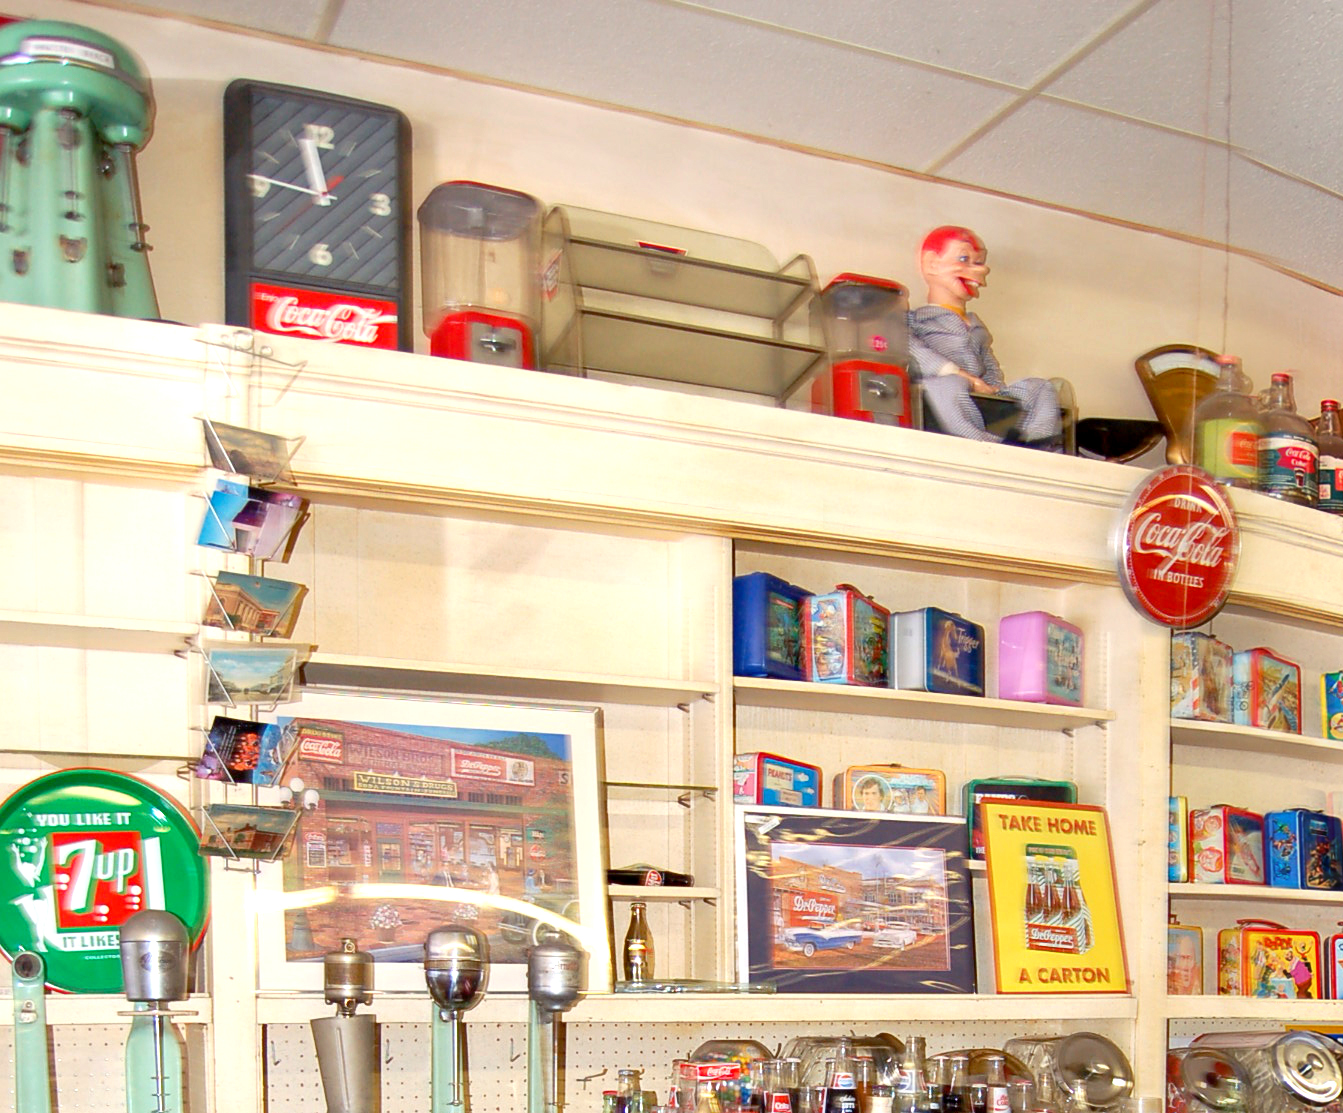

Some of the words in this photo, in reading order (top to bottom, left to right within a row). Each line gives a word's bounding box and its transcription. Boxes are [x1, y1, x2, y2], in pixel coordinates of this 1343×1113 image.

[369, 192, 392, 217] 3
[308, 243, 333, 266] 6
[266, 296, 384, 343] Coca-Cola
[1285, 448, 1312, 461] Coca-Cola
[1173, 497, 1203, 513] DRINK
[1134, 511, 1229, 570] Coca-Cola
[1153, 569, 1165, 580] IN
[1167, 572, 1204, 588] BOTTLES
[955, 627, 980, 654] Trigger
[300, 738, 342, 757] Coca-Cola
[767, 767, 792, 782] PEANUTS
[37, 813, 70, 826] YOU
[75, 813, 111, 826] LIKE
[117, 812, 131, 825] IT
[998, 814, 1042, 833] TAKE
[1047, 817, 1098, 836] HOME
[805, 898, 837, 918] Pepper
[62, 936, 76, 948] IT
[1262, 936, 1293, 950] POPEYE
[1018, 968, 1032, 984] A
[1038, 967, 1111, 984] CARTON
[706, 1065, 732, 1077] Coca-Cola
